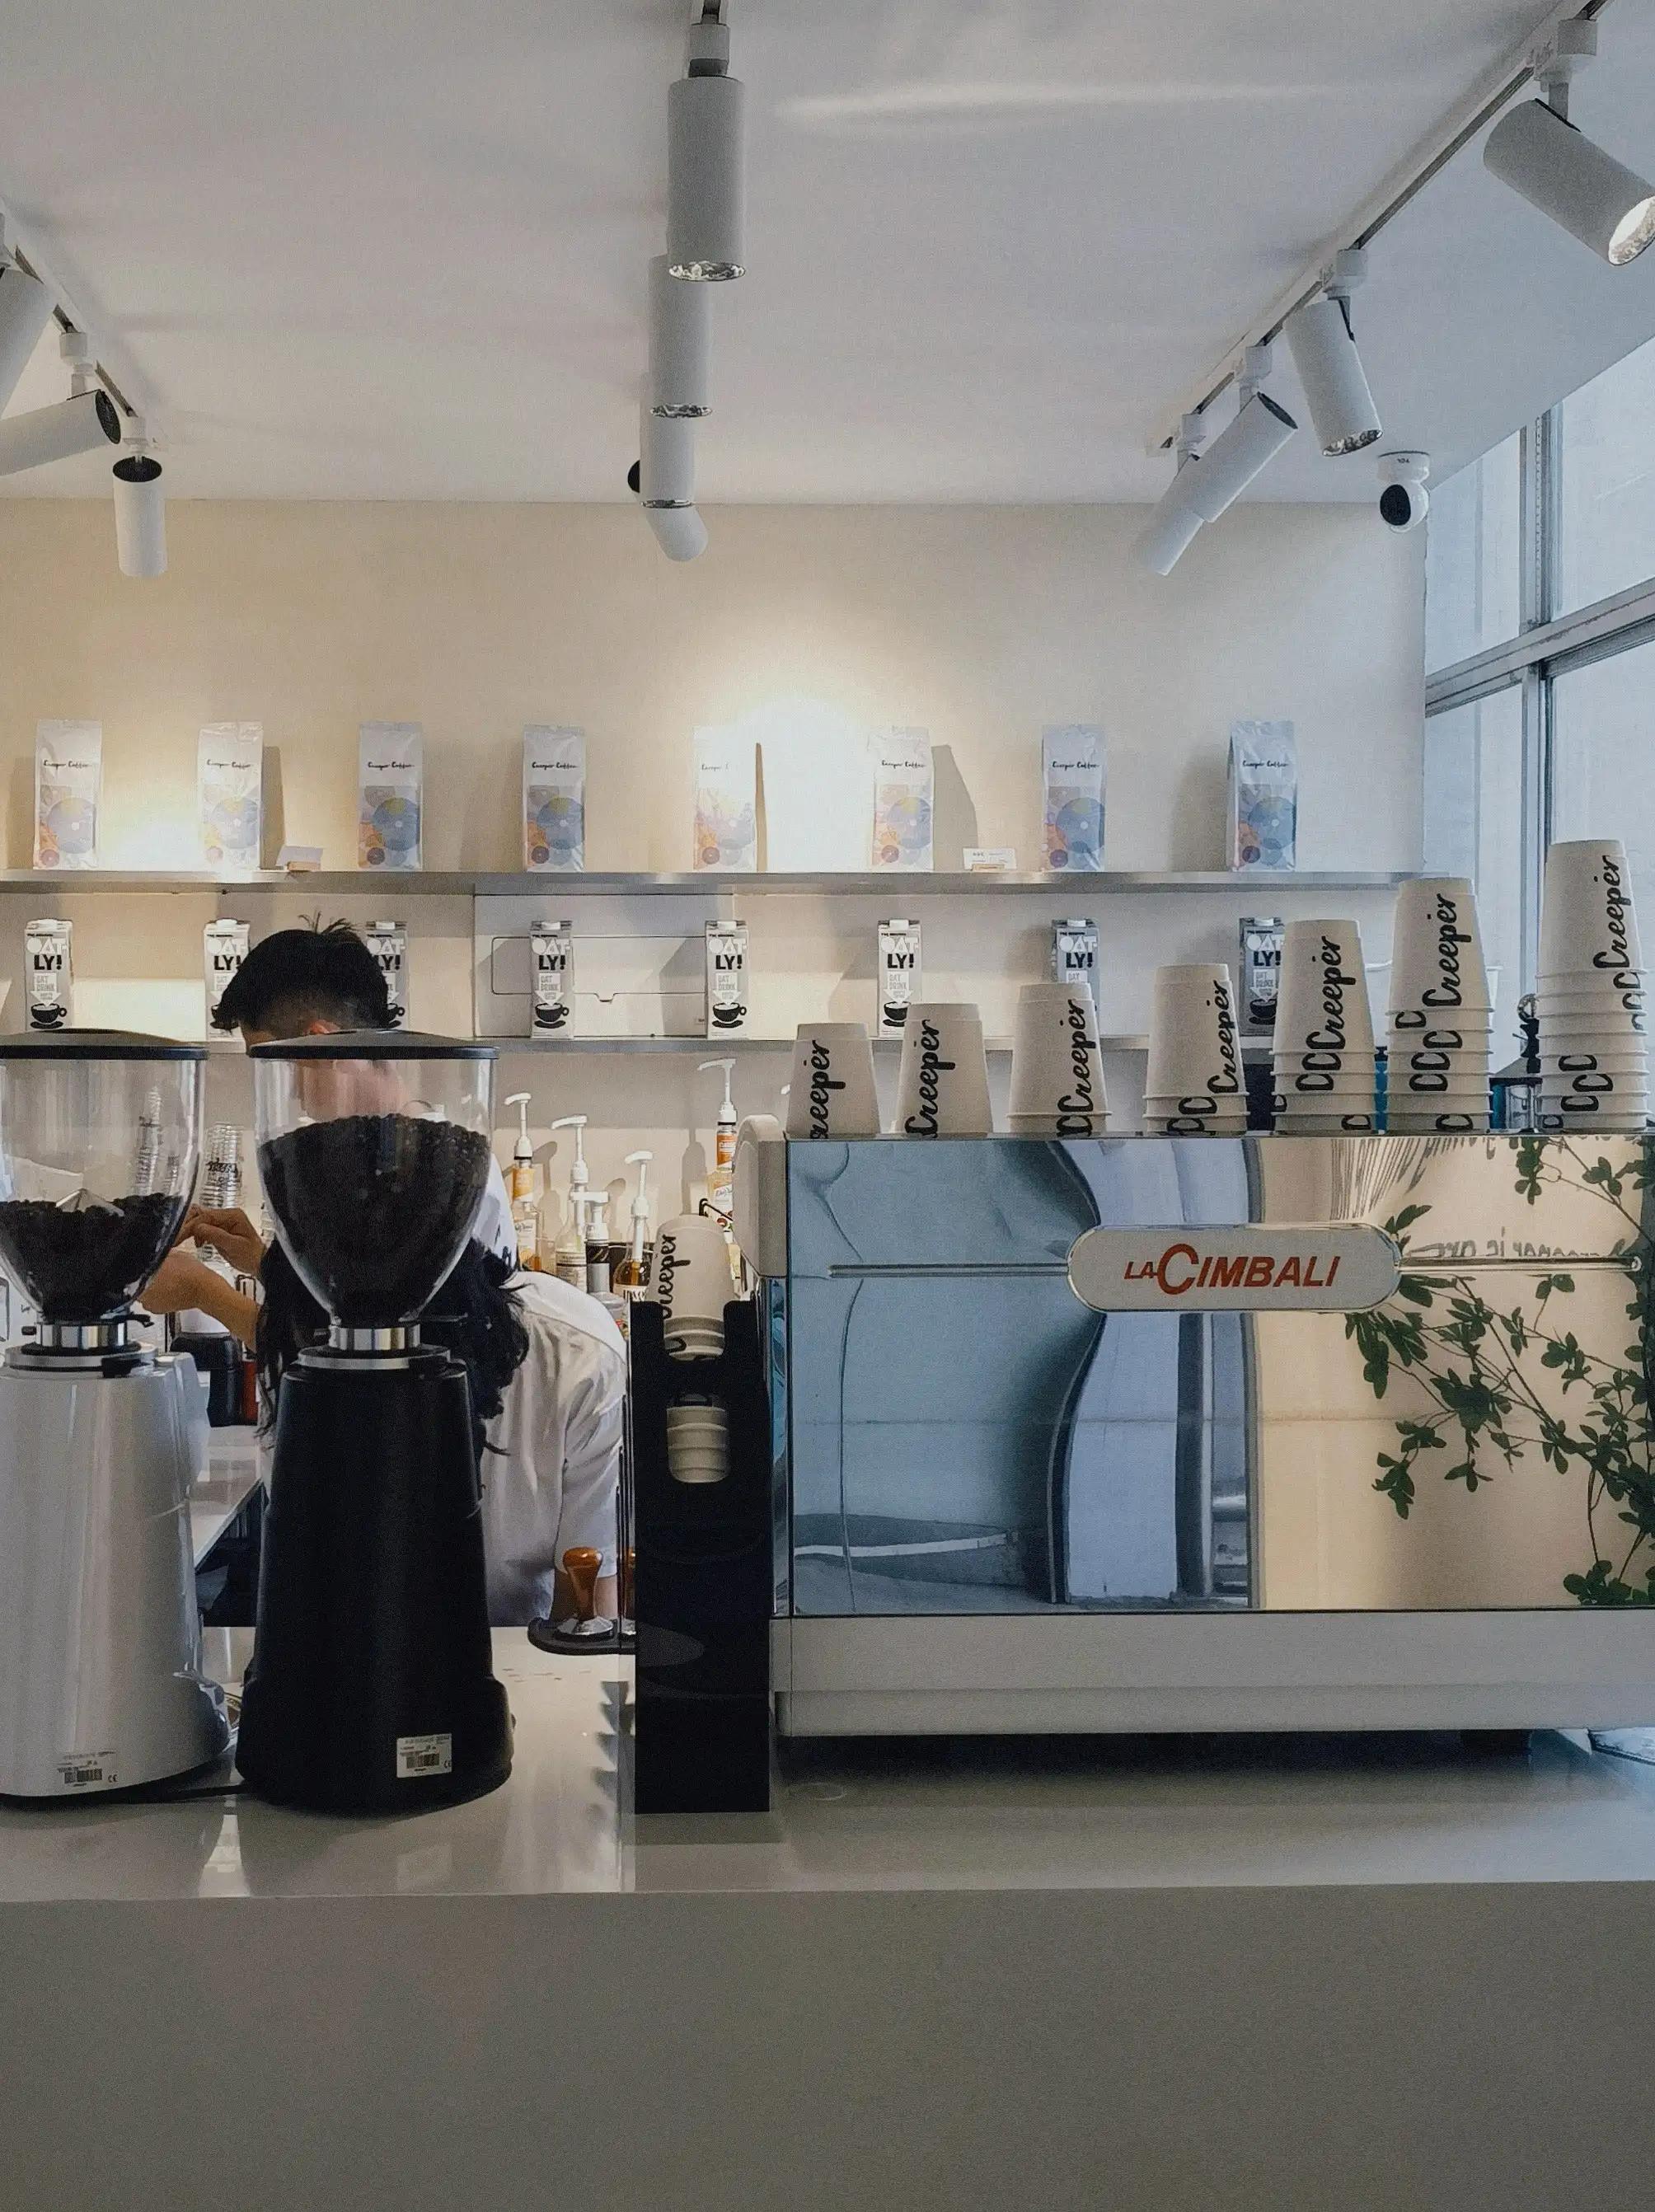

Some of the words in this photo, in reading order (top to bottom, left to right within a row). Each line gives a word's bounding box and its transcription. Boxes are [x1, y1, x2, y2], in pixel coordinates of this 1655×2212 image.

[34, 954, 62, 970] LY!
[539, 954, 566, 970] LY!
[715, 954, 743, 970] LY!
[888, 953, 914, 969] LY!
[1066, 952, 1093, 968] LY!
[1254, 950, 1281, 967] LY!
[1123, 1261, 1156, 1279] LA
[1157, 1243, 1341, 1295] CIMBALI
